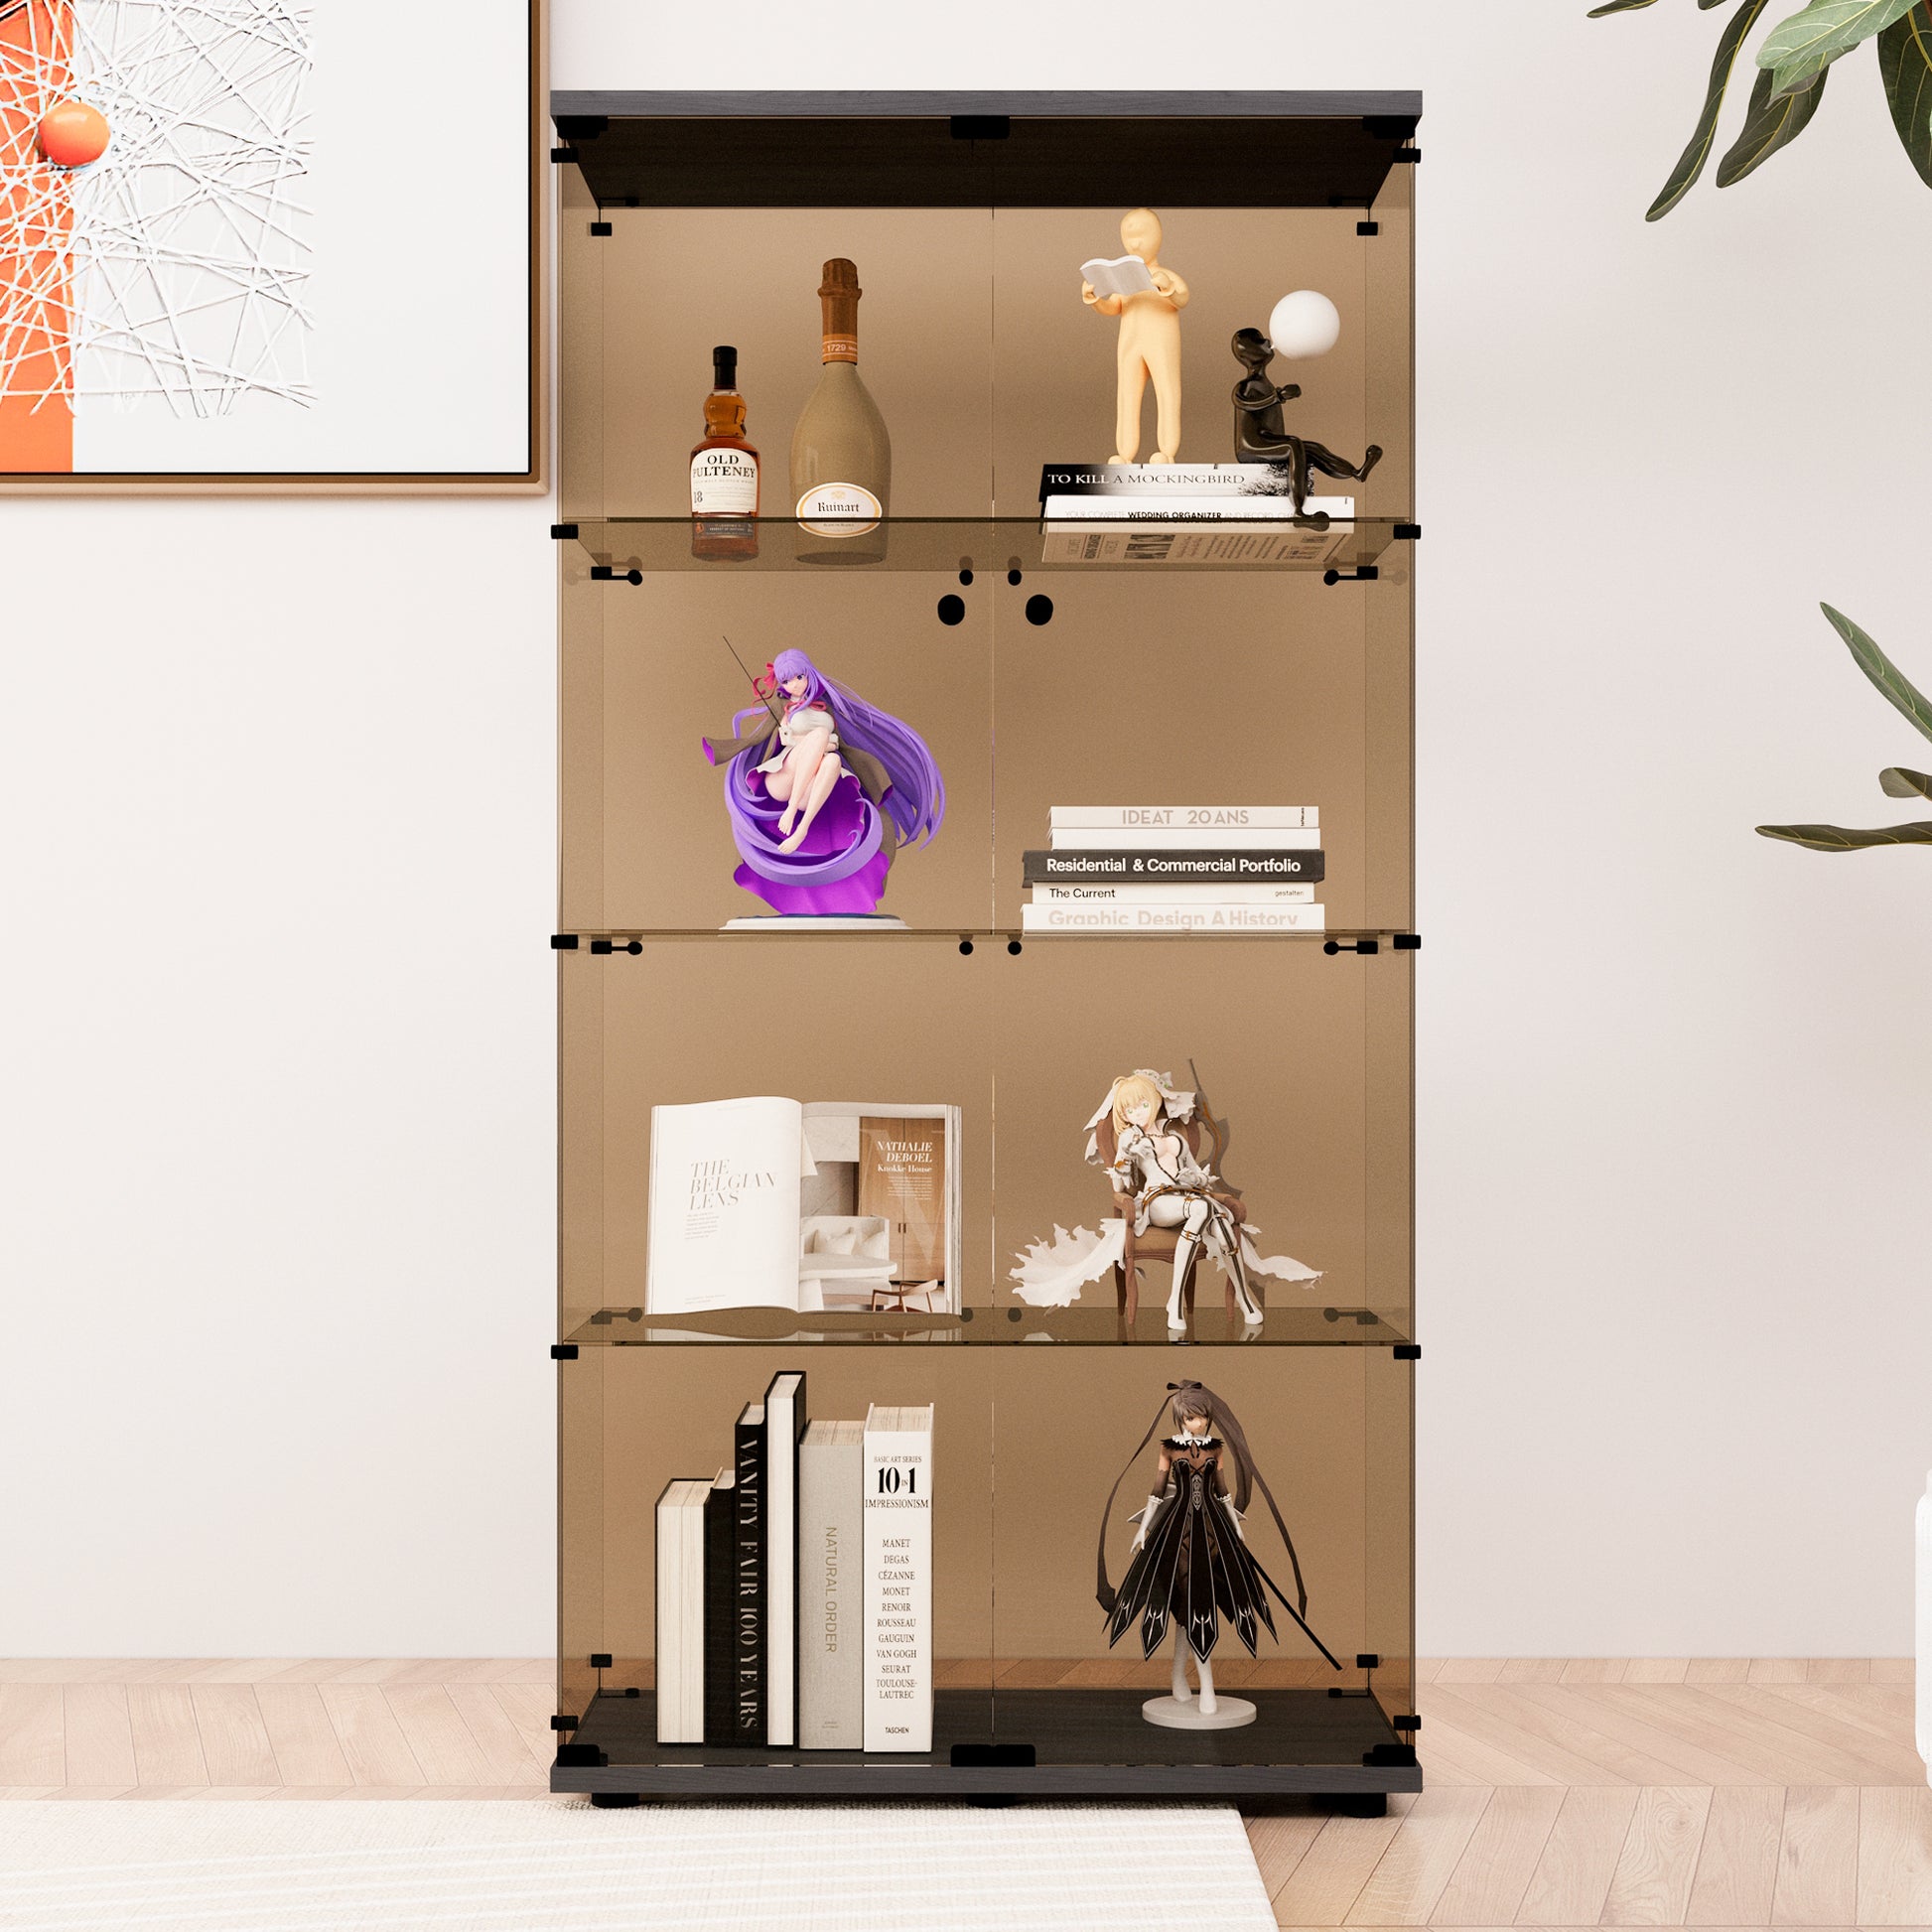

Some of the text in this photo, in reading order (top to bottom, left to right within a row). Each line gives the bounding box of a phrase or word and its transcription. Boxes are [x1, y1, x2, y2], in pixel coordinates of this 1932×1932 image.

[827, 344, 847, 352] 1729
[707, 454, 740, 466] OLD
[1047, 474, 1246, 484] TO KILL A MOCKINGBIRD
[817, 501, 861, 512] Ruinart
[1128, 511, 1171, 520] WEDDING
[1172, 511, 1222, 520] ORGANIZER
[1122, 809, 1249, 825] IDEAT 20 ANS
[1046, 857, 1302, 873] Residential & Commercial Portfolio
[1049, 888, 1116, 898] The Current
[1274, 889, 1304, 897] gestalten
[1047, 909, 1300, 931] Graphic Design A History
[877, 1140, 933, 1153] NATHALIE
[886, 1152, 933, 1164] DEBOEL
[690, 1159, 731, 1178] THE
[877, 1164, 932, 1173] Knokke House
[690, 1172, 776, 1194] BELGIAN
[690, 1191, 740, 1210] LENS
[740, 1440, 758, 1529] VANITY
[878, 1466, 900, 1494] 10
[907, 1466, 916, 1494] 1
[865, 1498, 929, 1509] IMPRESSIONISM
[882, 1538, 911, 1548] MANET
[884, 1555, 910, 1565] DEGAS
[740, 1541, 758, 1596] FAIR
[878, 1569, 915, 1581] CÉZANNE
[825, 1527, 838, 1653] NATURAL ORDER
[882, 1587, 910, 1596] MONET
[882, 1602, 911, 1612] RENOIR
[877, 1618, 916, 1628] ROUSSEAU
[878, 1633, 915, 1643] GAUGUIN
[877, 1649, 917, 1659] VAN GOGH
[881, 1664, 911, 1674] SEURAT
[876, 1678, 918, 1688] TOULOUSE-
[740, 1653, 758, 1728] YEARS
[879, 1690, 914, 1700] LAUTREC
